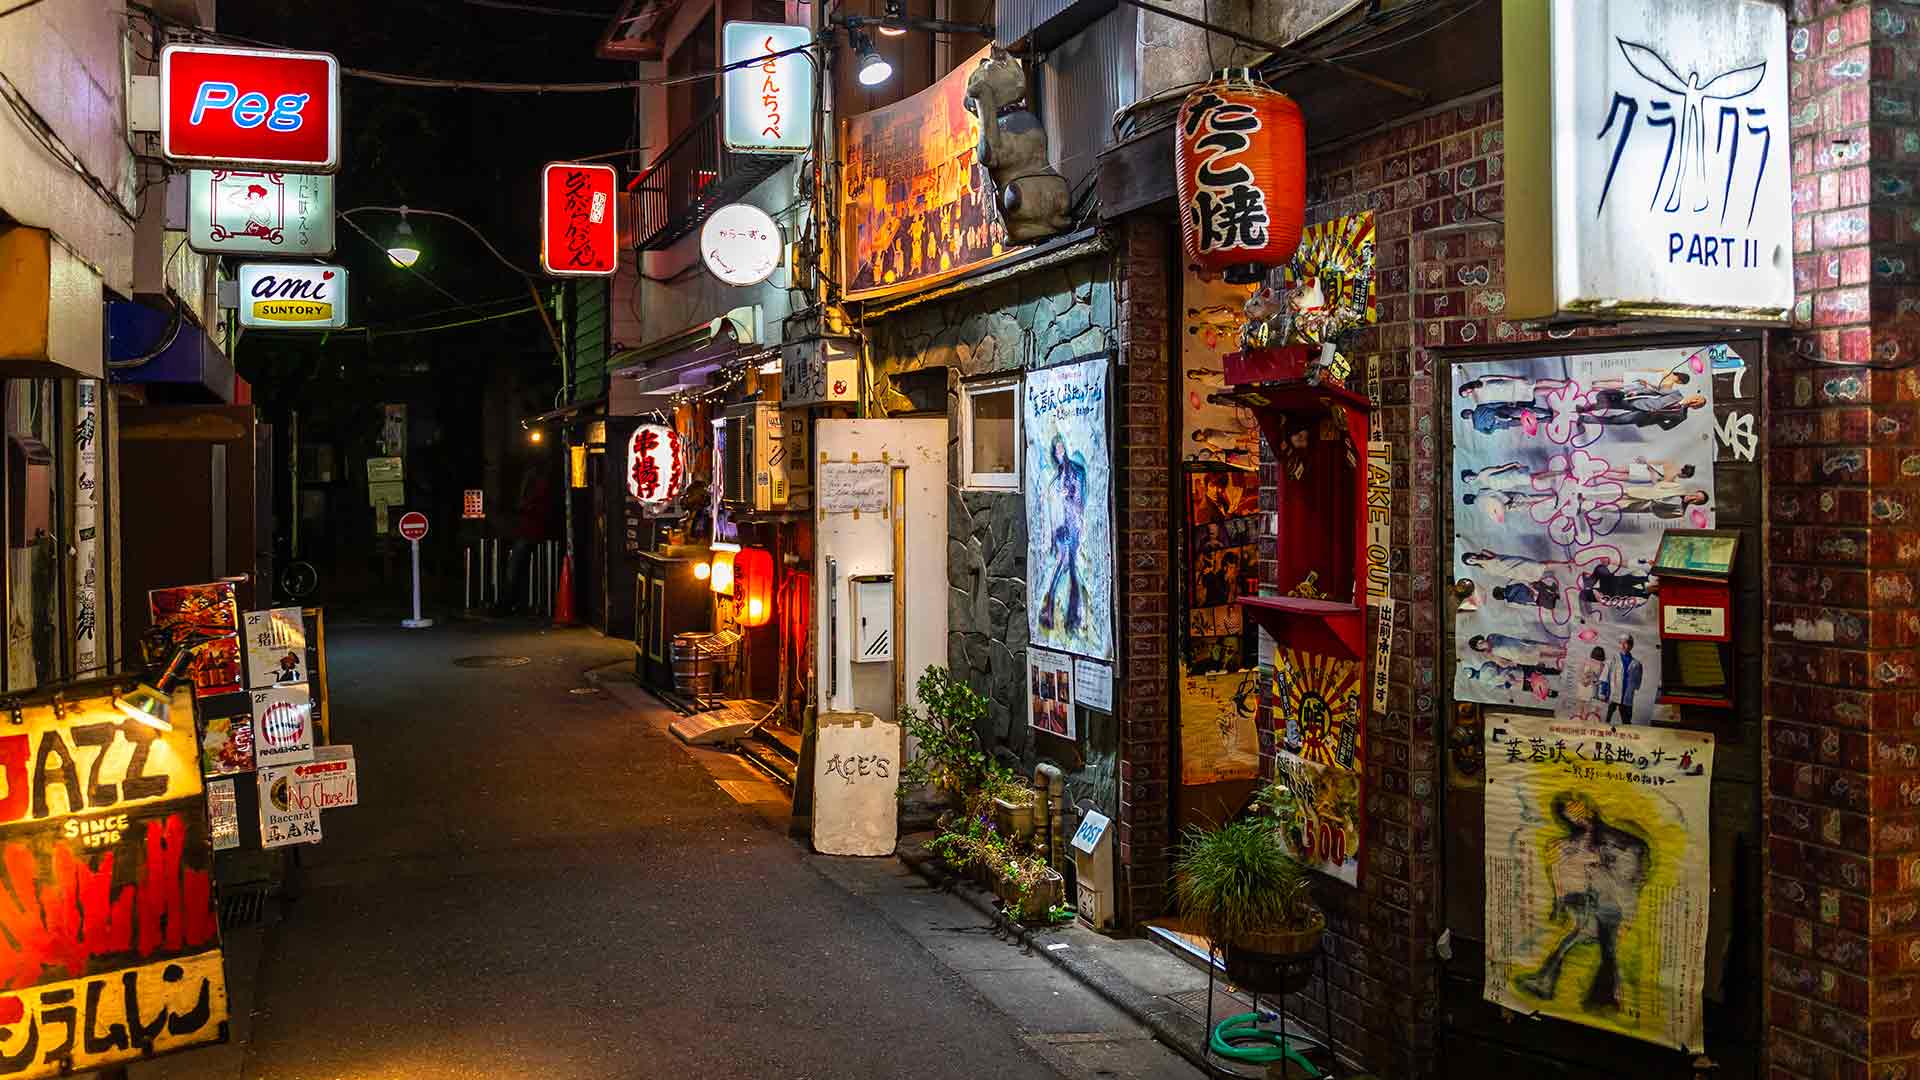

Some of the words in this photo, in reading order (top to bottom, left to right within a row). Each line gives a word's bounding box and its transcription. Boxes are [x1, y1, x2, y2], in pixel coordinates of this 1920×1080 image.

[190, 81, 310, 132] Peg
[1184, 94, 1270, 250] たこ焼
[1669, 232, 1735, 268] PART
[251, 273, 327, 300] ami
[262, 305, 324, 316] SUNTORY
[248, 615, 261, 625] 2F
[254, 693, 268, 704] 2F
[262, 771, 275, 782] 1F
[288, 784, 312, 812] No
[64, 814, 129, 838] SINCE
[270, 810, 314, 825] Baccarat
[1076, 821, 1103, 845] POST
